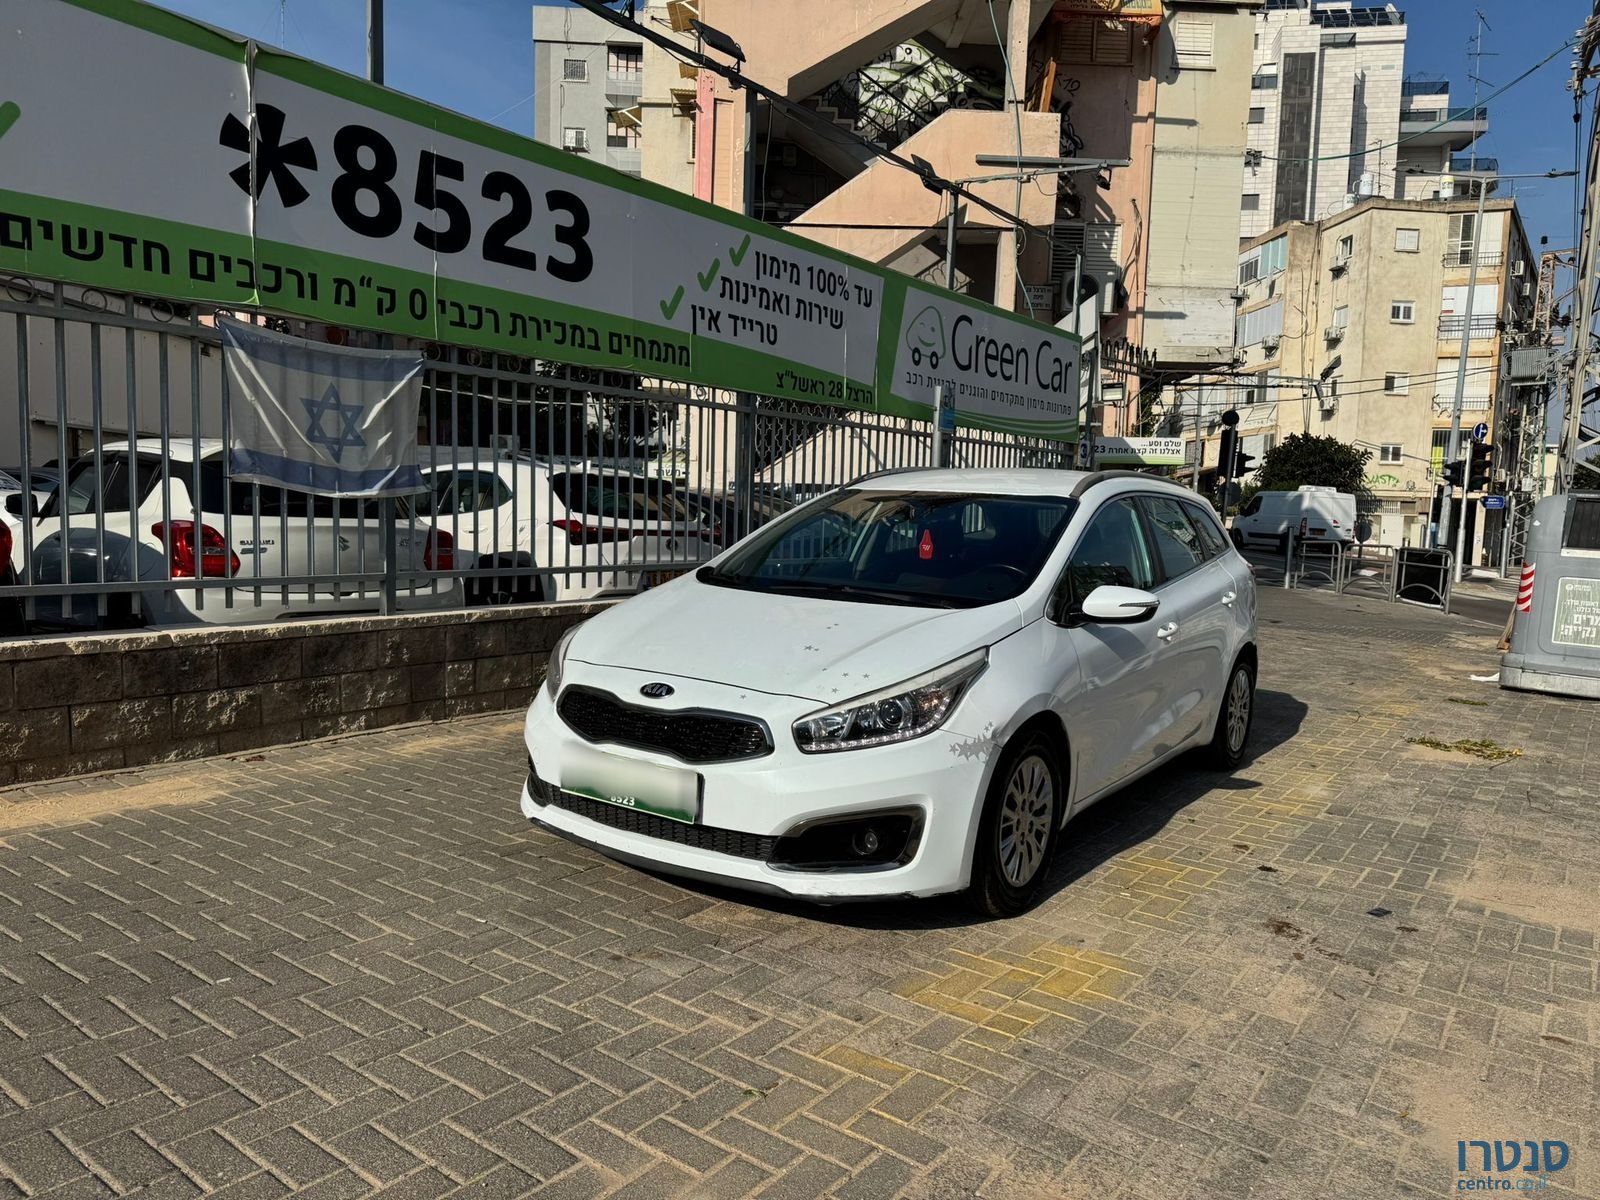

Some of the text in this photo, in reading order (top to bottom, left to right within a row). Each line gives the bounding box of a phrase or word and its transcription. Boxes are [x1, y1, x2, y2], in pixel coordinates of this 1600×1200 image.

[0, 212, 170, 275] חדשים
[189, 248, 319, 301] ורכבים
[755, 251, 873, 308] עד 100% מימון
[409, 288, 427, 321] 0
[719, 276, 844, 329] שירות ואמינות
[437, 298, 500, 334] רכבי
[691, 304, 778, 346] טרייד אין
[509, 312, 601, 351] במכירת
[608, 331, 690, 368] מתמחים
[952, 314, 1072, 394] Green Car
[828, 380, 843, 398] 28
[906, 371, 923, 386] רכב
[846, 381, 873, 404] הרצל
[960, 383, 988, 399] והוגנים
[991, 390, 1025, 407] מתקדמים
[1027, 396, 1045, 410] מימון
[1047, 401, 1072, 416] פתרונות
[1108, 447, 1129, 455] אחרת
[1159, 447, 1181, 455] אצלנו
[1164, 439, 1181, 447] שלם
[643, 683, 667, 696] KIA
